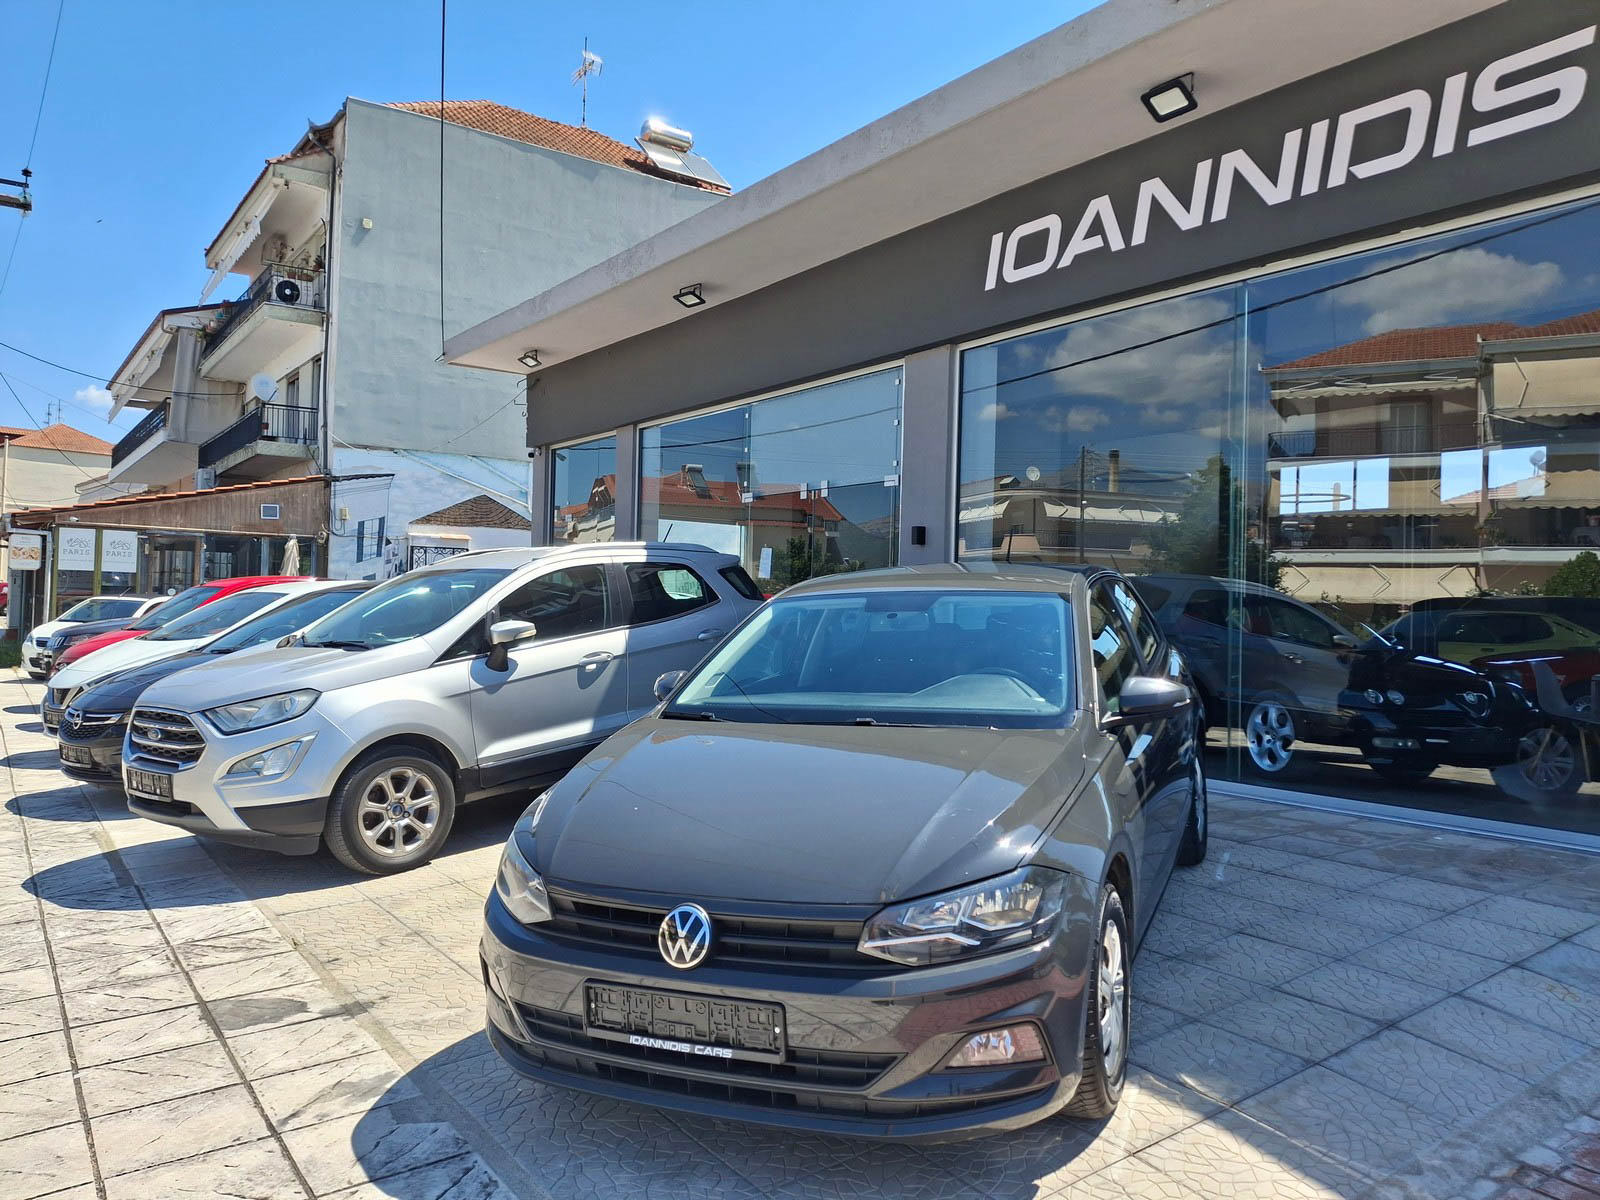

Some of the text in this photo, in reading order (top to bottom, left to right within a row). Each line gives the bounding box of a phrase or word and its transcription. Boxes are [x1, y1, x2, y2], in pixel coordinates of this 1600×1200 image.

[984, 25, 1597, 292] IOANNIDIS
[63, 548, 90, 556] PARIS
[629, 1034, 733, 1059] IOANNIDIS CARS
